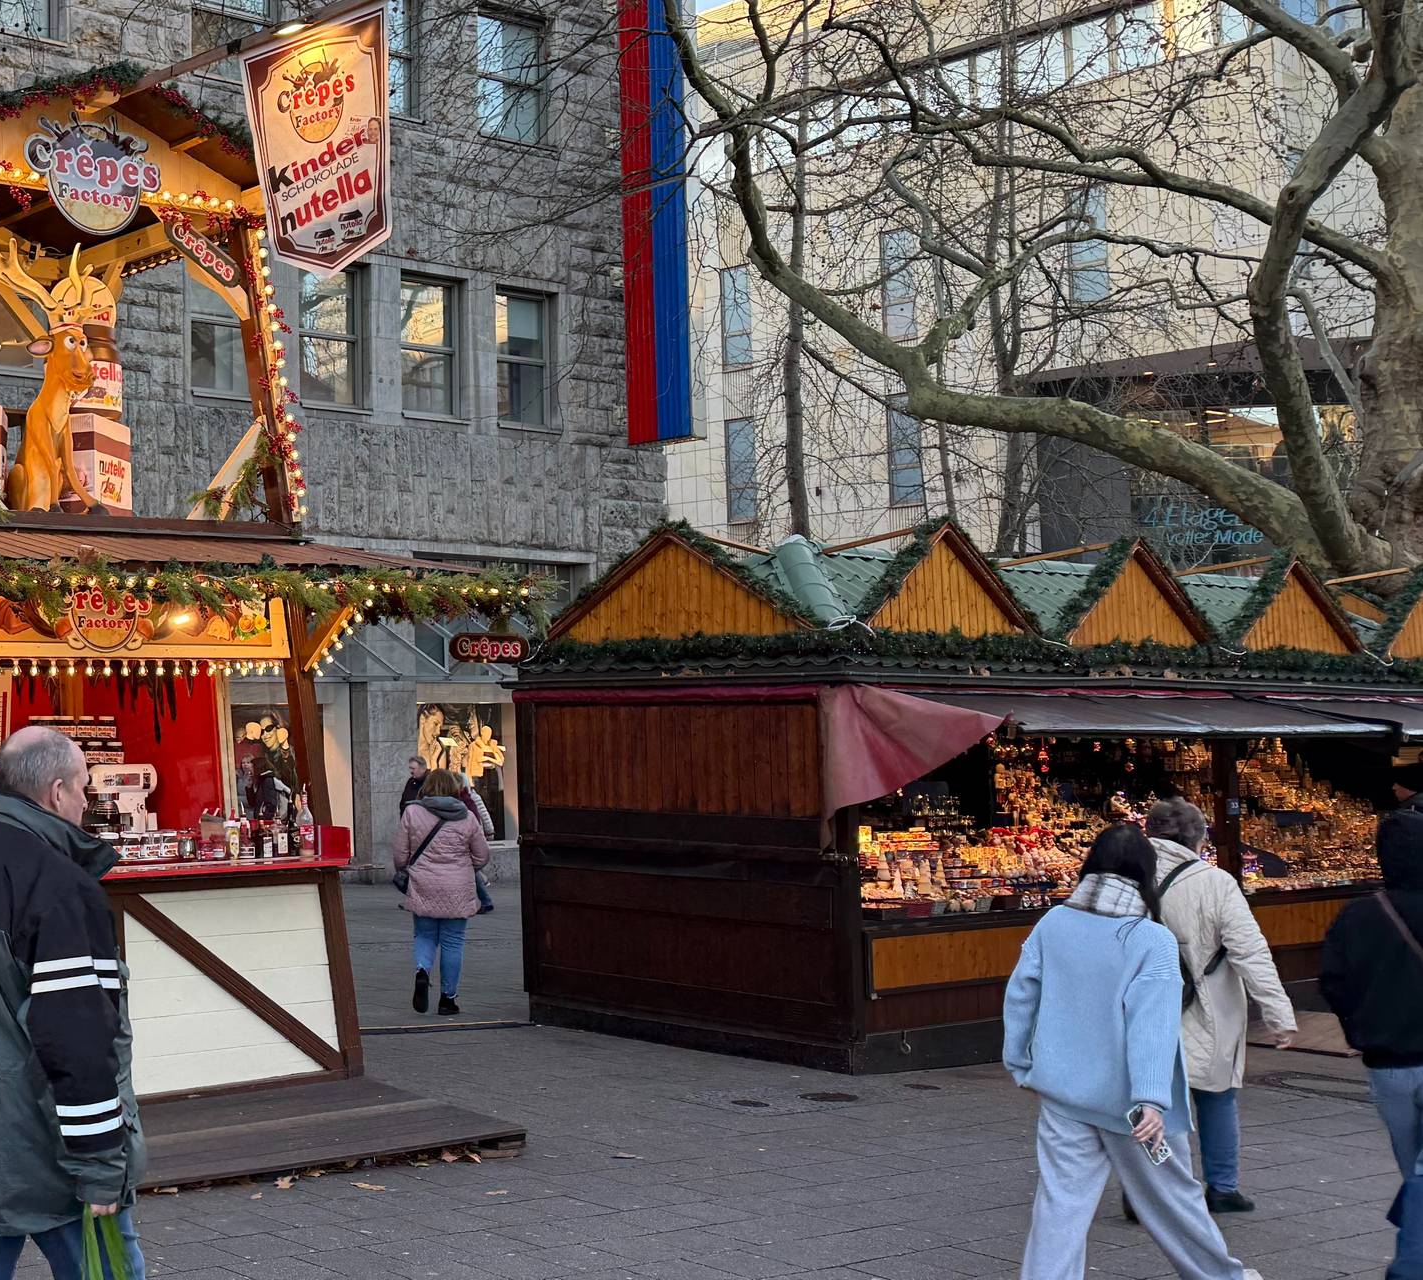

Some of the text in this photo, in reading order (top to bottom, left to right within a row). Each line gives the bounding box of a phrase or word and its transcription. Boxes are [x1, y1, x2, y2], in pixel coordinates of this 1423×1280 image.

[277, 73, 356, 114] Crêpes
[294, 106, 341, 129] Factory
[25, 133, 161, 193] Crêpes
[281, 152, 360, 203] SCHOKOLADE
[58, 182, 134, 212] Factory
[280, 168, 373, 238] nutella
[172, 222, 237, 282] Crêpes
[99, 459, 125, 479] nutella
[1215, 527, 1264, 544] Mode
[77, 615, 133, 631] Factory
[458, 637, 521, 660] Crêpes
